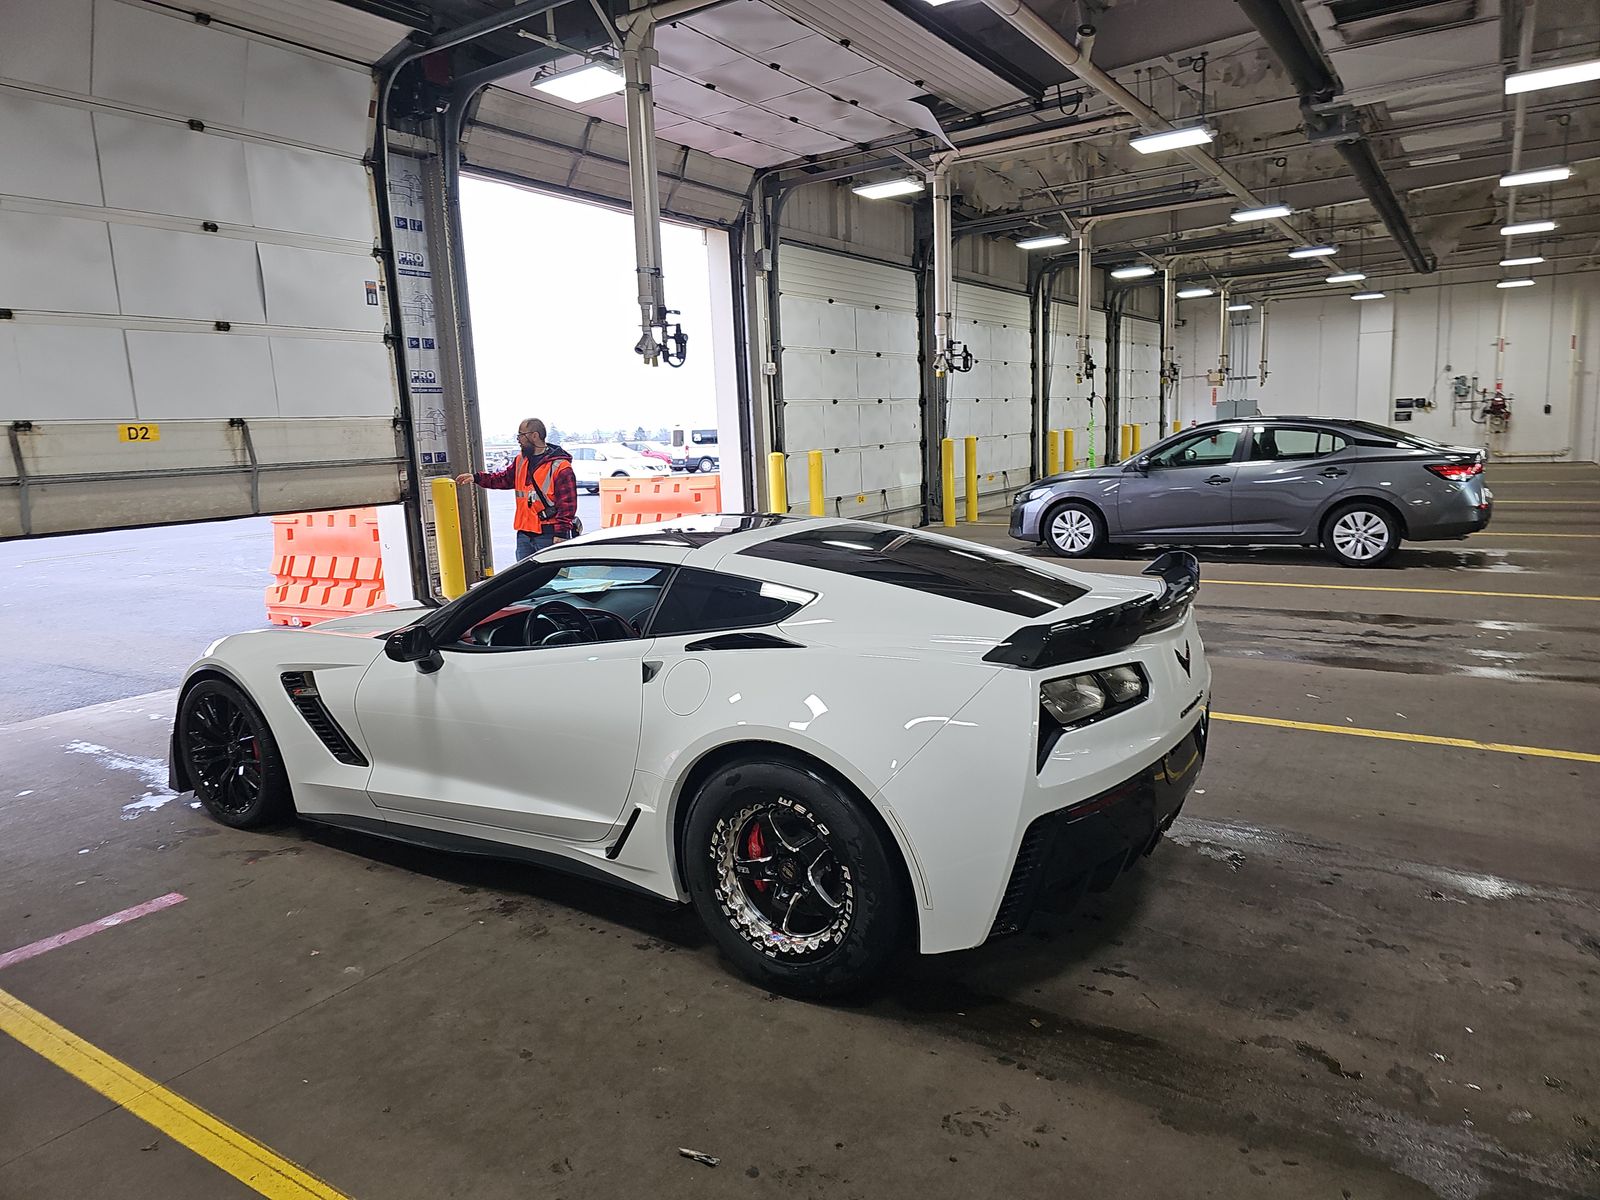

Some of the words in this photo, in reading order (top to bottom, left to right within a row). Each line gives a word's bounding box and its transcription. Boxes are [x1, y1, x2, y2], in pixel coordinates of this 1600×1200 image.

[398, 252, 423, 263] PRO
[411, 371, 435, 379] PRO
[127, 426, 151, 440] D2
[777, 796, 830, 836] WELD
[709, 818, 725, 859] USA
[833, 865, 854, 945] RACING
